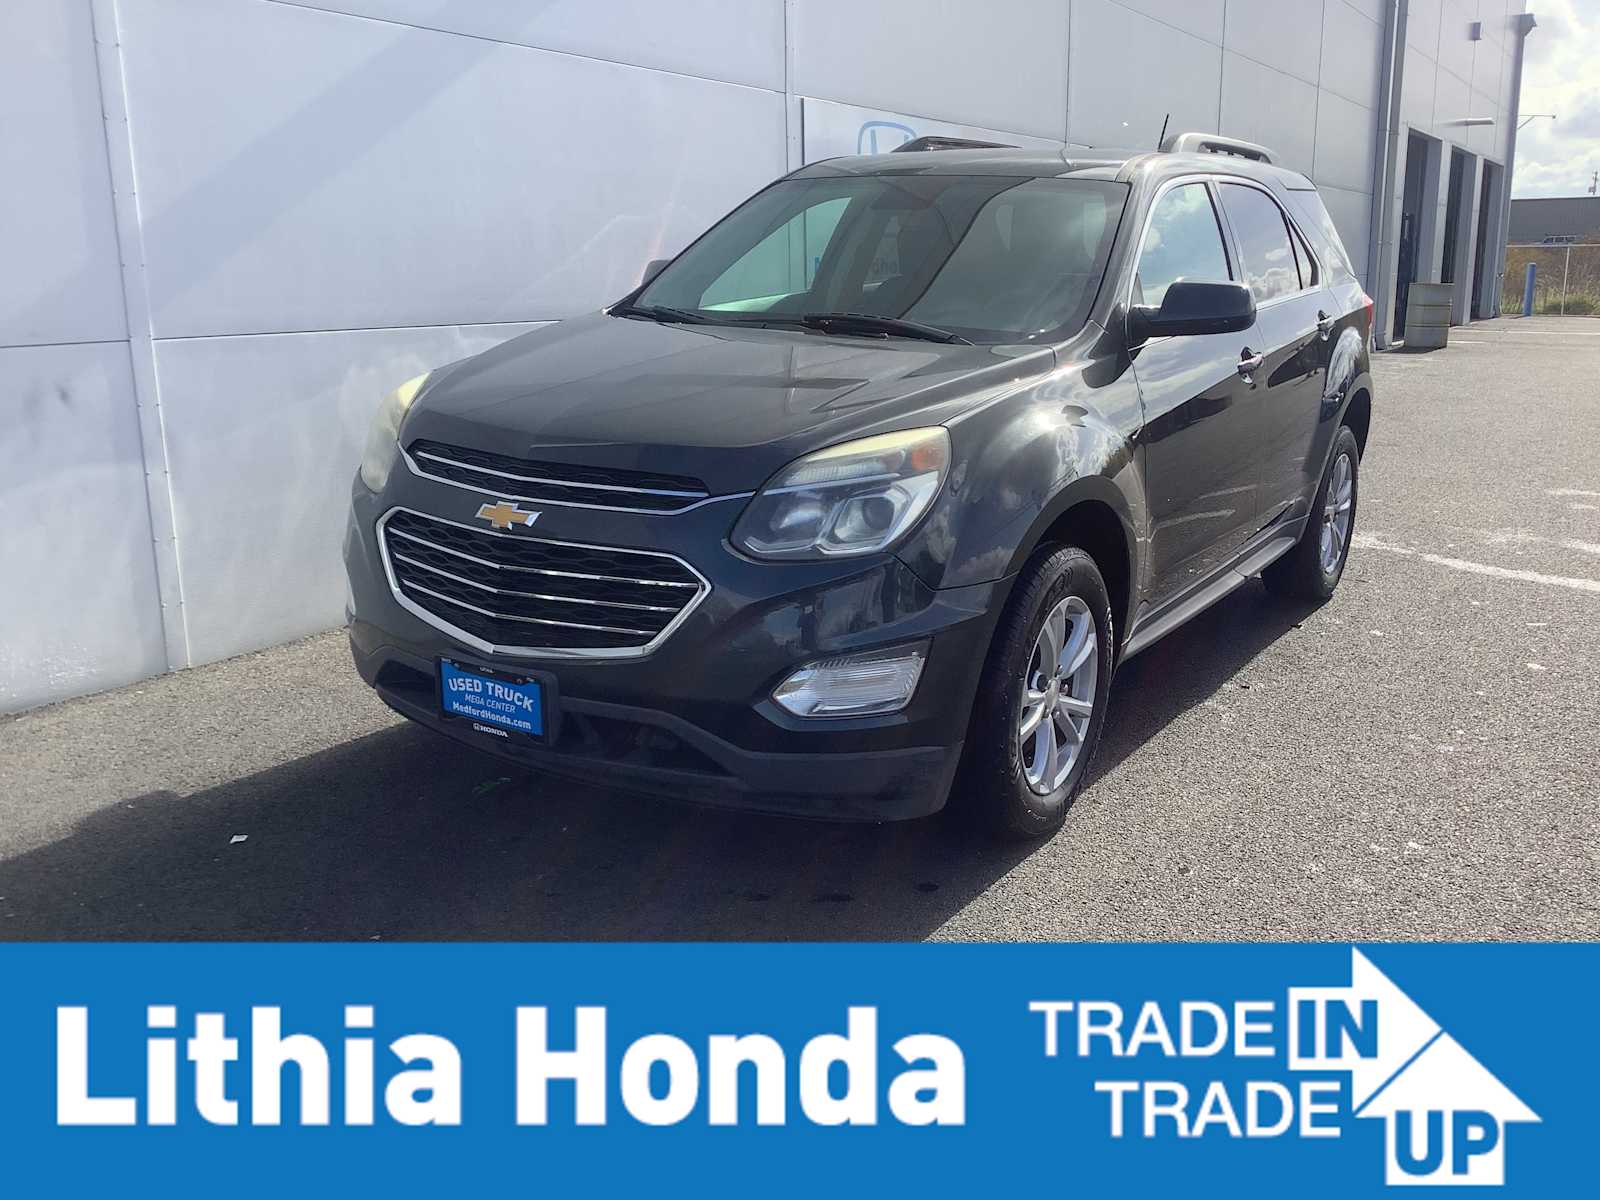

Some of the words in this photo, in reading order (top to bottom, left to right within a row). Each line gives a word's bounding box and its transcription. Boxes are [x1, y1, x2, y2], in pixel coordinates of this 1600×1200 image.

[448, 678, 482, 693] USED
[486, 682, 534, 712] TRUCK
[464, 693, 485, 706] MEGA
[486, 699, 516, 713] CENTER
[452, 701, 532, 730] MedfordHonda.com
[479, 725, 509, 738] HONDA
